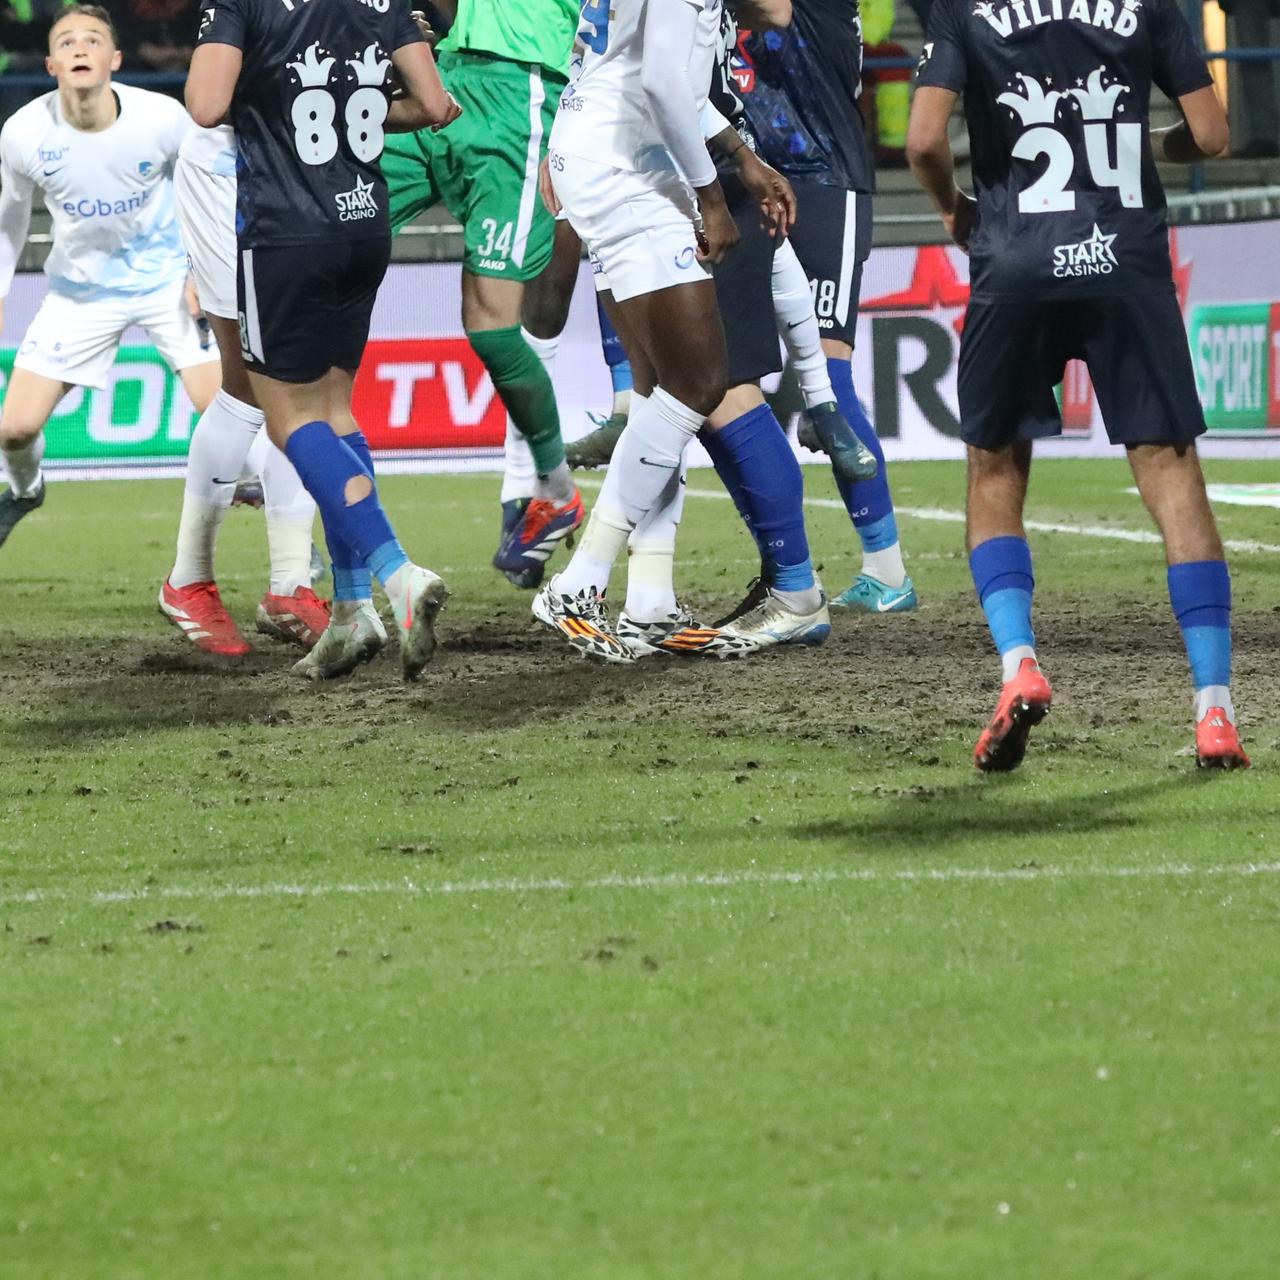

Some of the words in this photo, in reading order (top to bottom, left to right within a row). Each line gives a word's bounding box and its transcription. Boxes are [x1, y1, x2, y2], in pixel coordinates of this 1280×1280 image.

[291, 87, 389, 166] 88
[1011, 122, 1144, 214] 24
[335, 192, 375, 213] STAR
[339, 209, 376, 221] CASINO
[477, 218, 513, 261] 34
[478, 258, 506, 271] JAKO
[1053, 242, 1109, 267] STAR
[1053, 262, 1113, 278] CASINO
[818, 319, 834, 329] KO
[1197, 323, 1268, 412] SPORT
[375, 361, 497, 428] TV
